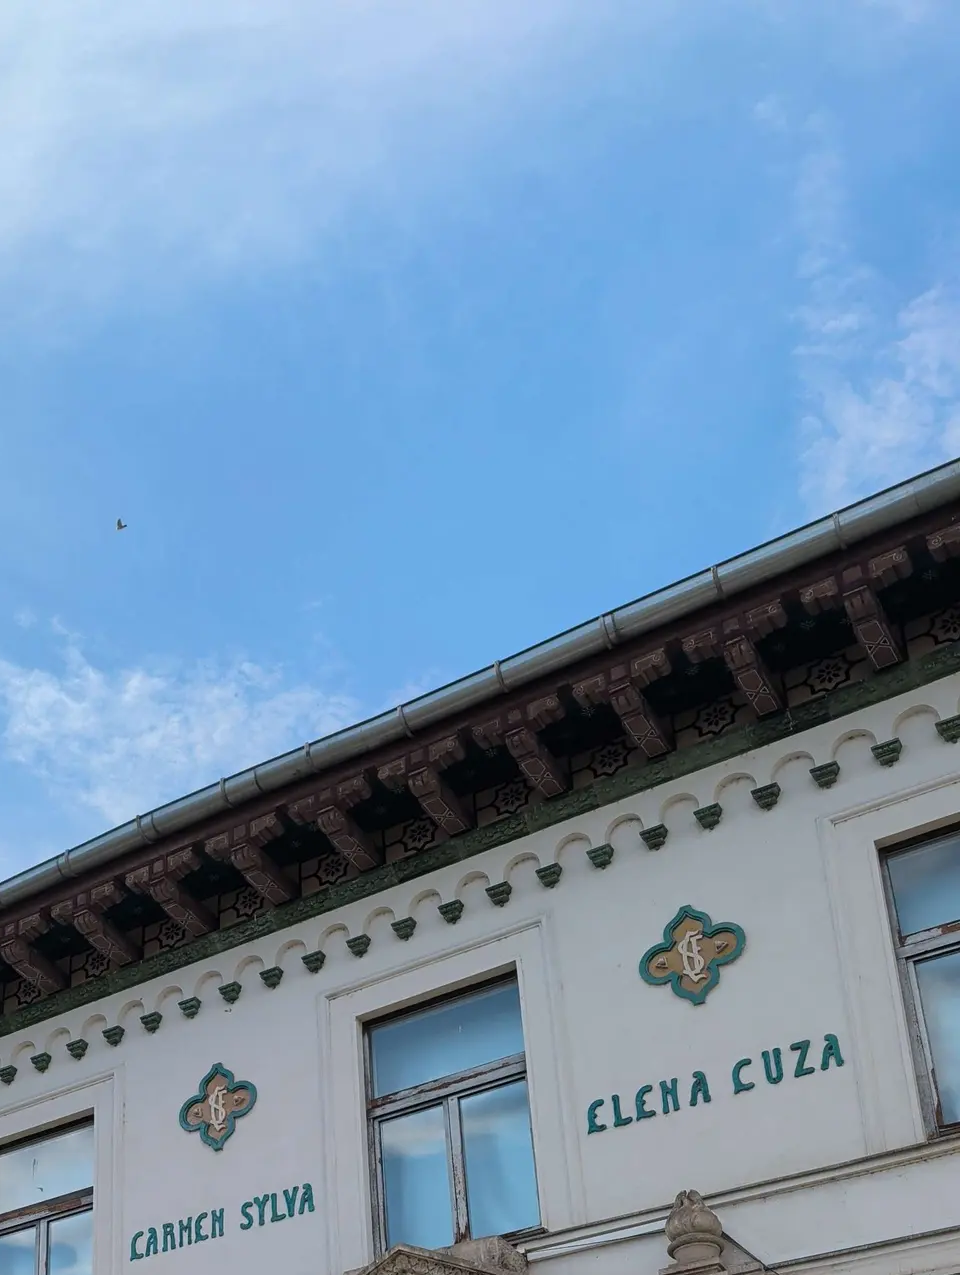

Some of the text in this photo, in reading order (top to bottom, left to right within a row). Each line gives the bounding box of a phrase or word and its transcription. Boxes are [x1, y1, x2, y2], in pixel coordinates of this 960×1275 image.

[587, 1033, 844, 1135] ELENA CUZA
[129, 1183, 315, 1262] CARMEN SYLVA
